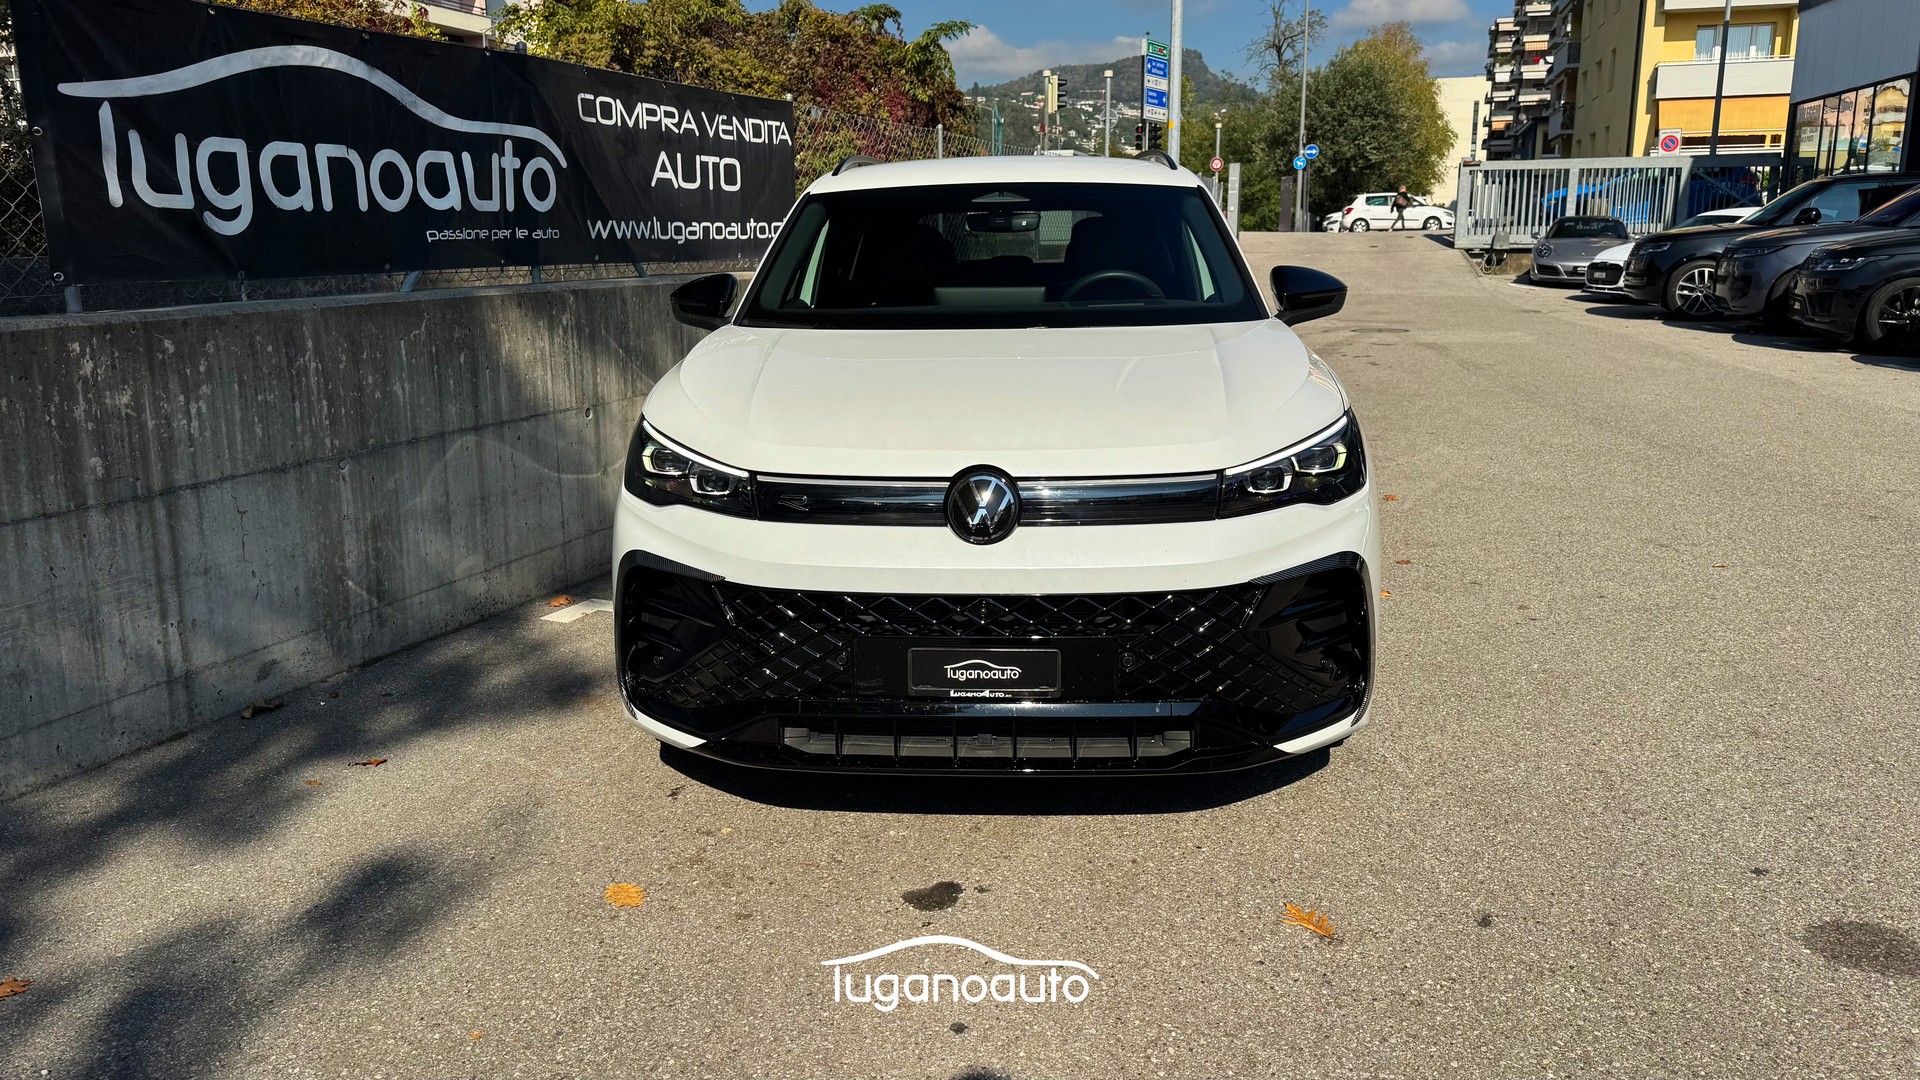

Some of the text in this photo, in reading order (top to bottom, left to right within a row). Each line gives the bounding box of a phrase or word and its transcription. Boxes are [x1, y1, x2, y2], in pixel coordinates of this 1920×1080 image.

[577, 92, 793, 146] COMPRA VENDITA
[98, 101, 557, 236] luganoauto
[651, 150, 742, 192] AUTO
[426, 226, 560, 243] passione per le auto
[587, 216, 786, 245] www.luganoauto.c
[947, 667, 1020, 682] luganoauto
